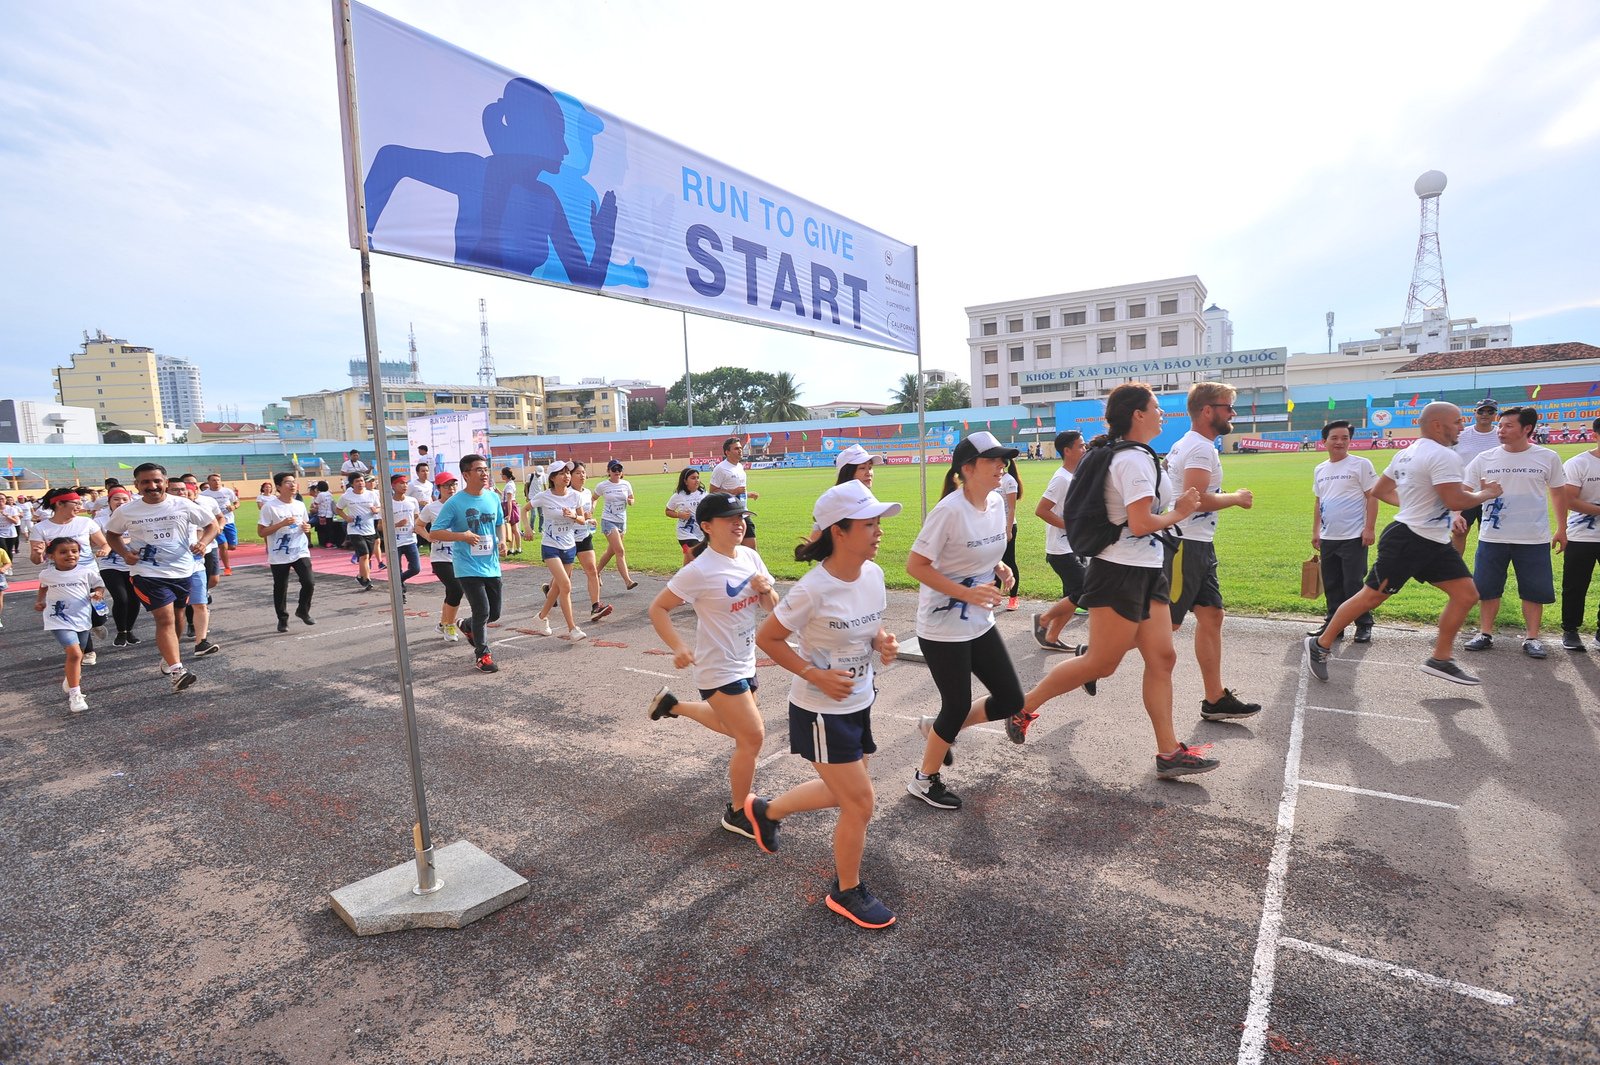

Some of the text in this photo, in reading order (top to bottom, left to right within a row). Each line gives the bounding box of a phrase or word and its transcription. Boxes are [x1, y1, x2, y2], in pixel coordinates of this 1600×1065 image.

[681, 165, 854, 261] RUN TO GIVE
[685, 223, 868, 330] START
[1242, 438, 1272, 449] V.LEAGUE
[990, 533, 1001, 542] GIVE
[730, 598, 747, 613] JUST
[829, 621, 850, 630] RUN
[850, 618, 860, 627] TO
[861, 614, 876, 624] GIVE
